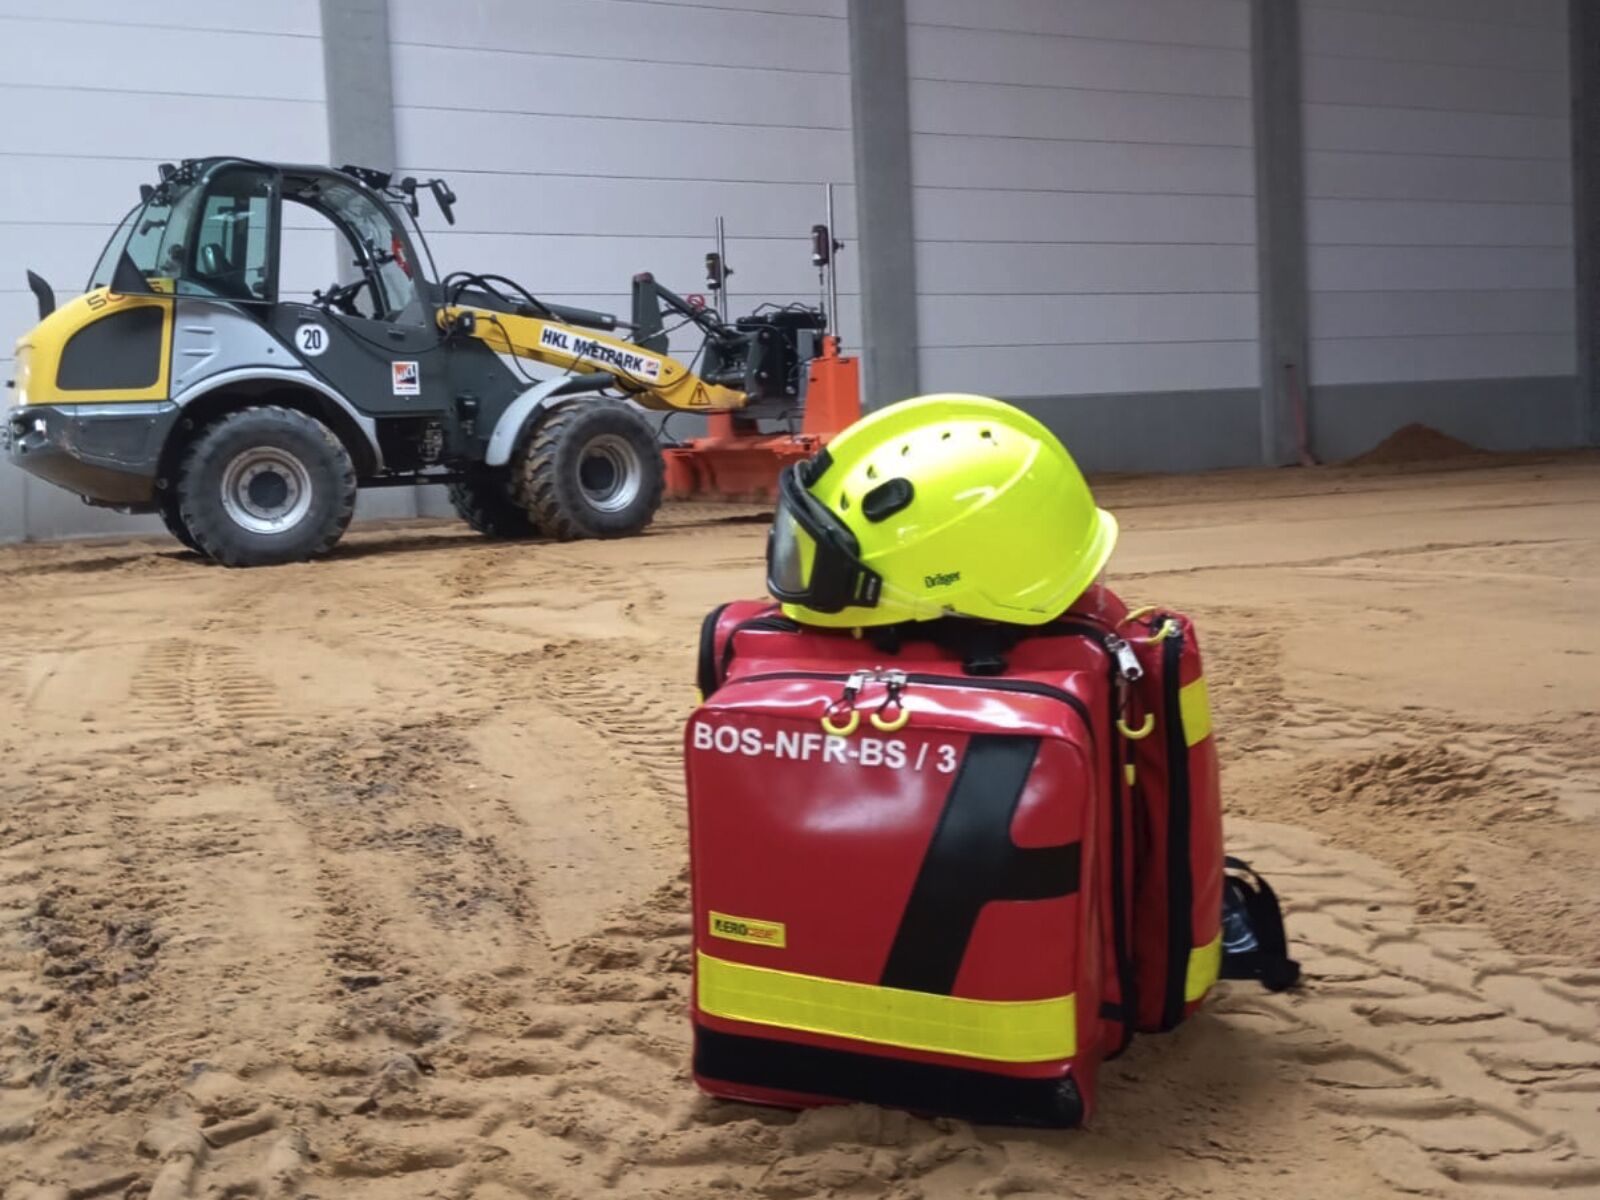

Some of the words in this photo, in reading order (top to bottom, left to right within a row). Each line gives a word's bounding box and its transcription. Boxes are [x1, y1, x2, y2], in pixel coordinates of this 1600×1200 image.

[302, 328, 322, 350] 20
[541, 327, 569, 349] HKL
[573, 338, 644, 371] MIETPARK
[693, 721, 907, 769] BOS-NFR-BS
[914, 742, 929, 771] /
[936, 744, 957, 773] 3
